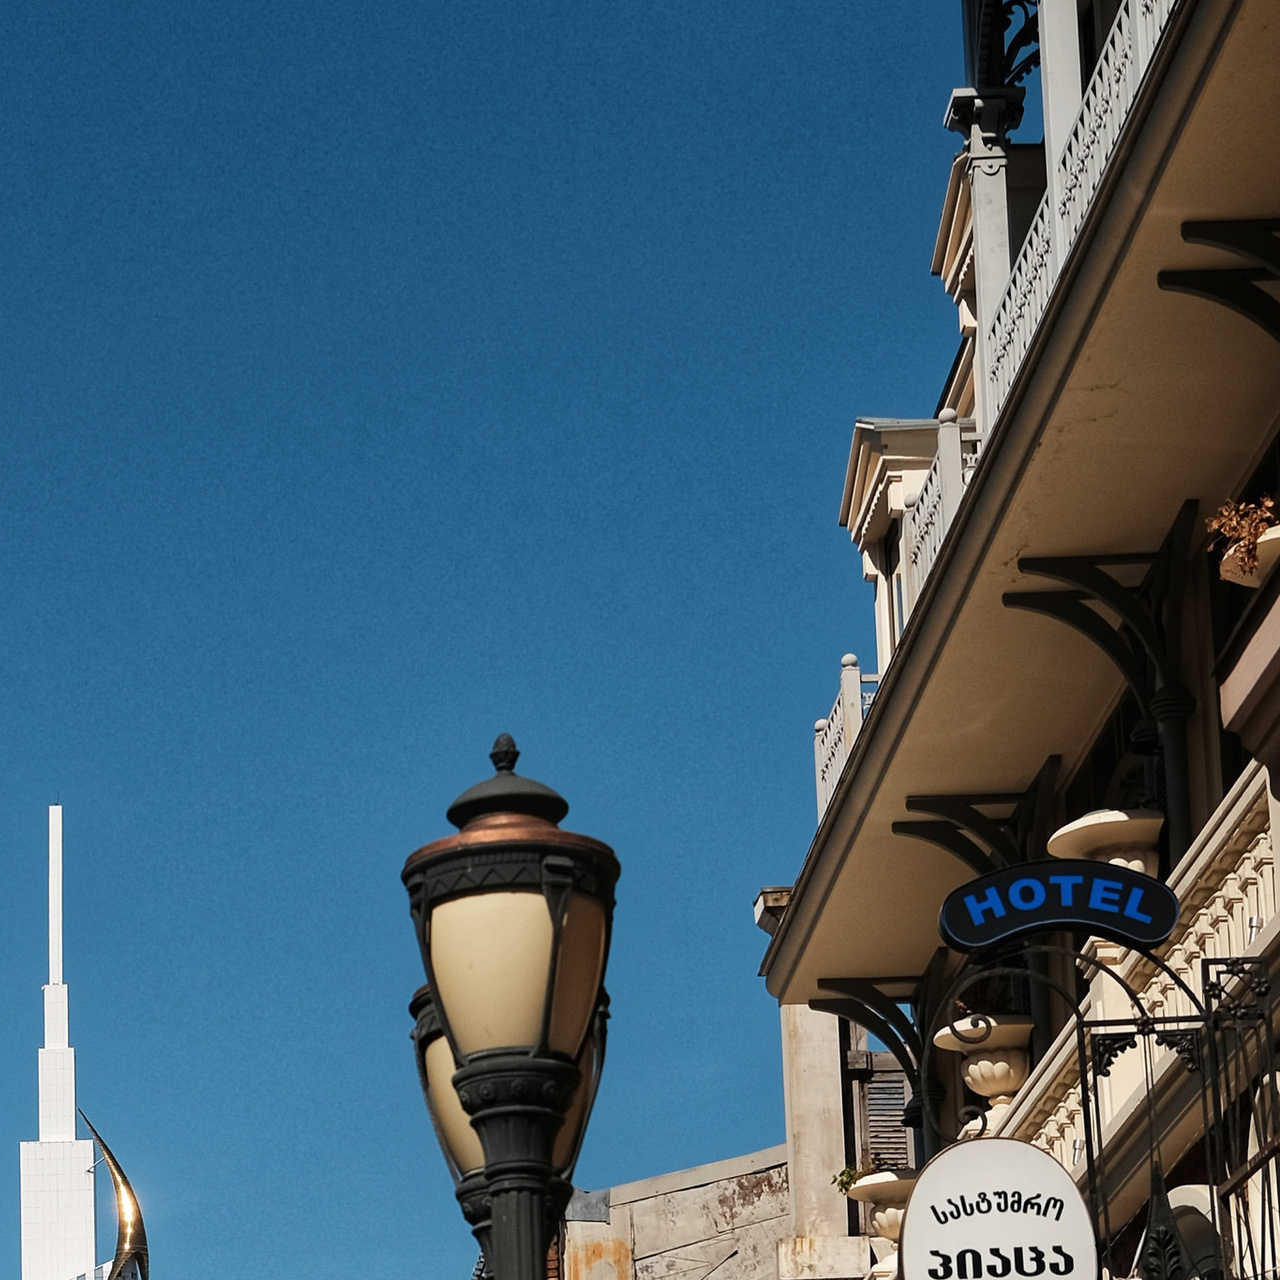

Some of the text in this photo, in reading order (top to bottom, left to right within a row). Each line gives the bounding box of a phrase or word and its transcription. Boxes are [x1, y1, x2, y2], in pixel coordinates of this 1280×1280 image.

[963, 875, 1153, 926] HOTEL
[929, 1190, 1065, 1225] სასტუმრო
[927, 1245, 1074, 1280] პიაცა
